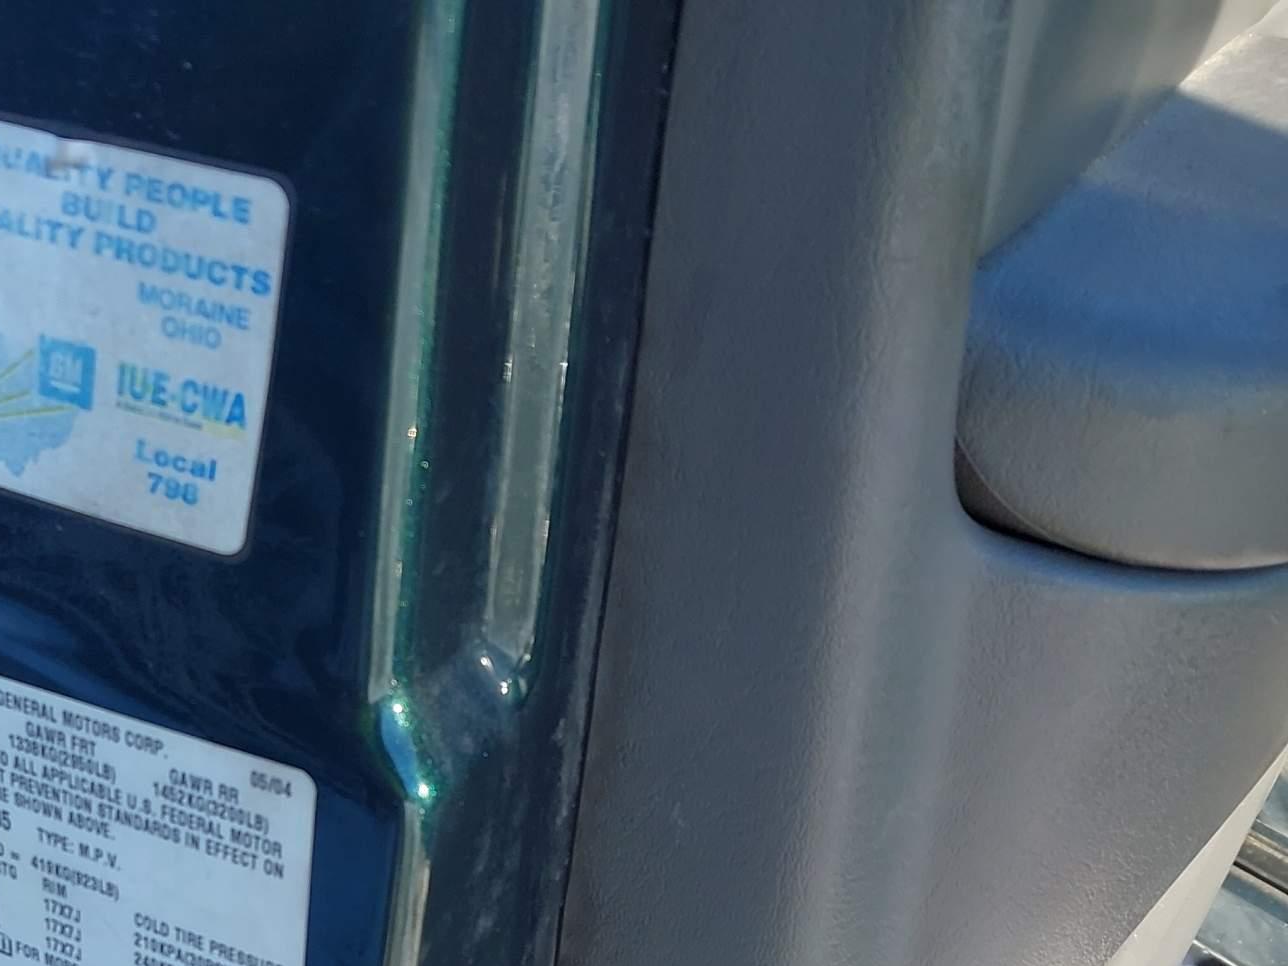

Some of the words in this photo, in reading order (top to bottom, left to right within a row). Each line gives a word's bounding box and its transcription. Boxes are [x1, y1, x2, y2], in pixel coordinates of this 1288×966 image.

[62, 191, 157, 234] BUILD
[125, 173, 252, 225] PEOPLE
[94, 230, 271, 295] PRODUCTS
[139, 281, 251, 331] MORAINE
[161, 316, 222, 350] OHIO
[50, 350, 83, 383] GM
[117, 363, 246, 430] IUE-CWA
[136, 438, 217, 482] Local
[25, 720, 66, 748] GAWR
[70, 734, 95, 756] FRT
[61, 709, 120, 742] MOTORS
[124, 730, 168, 758] CORP.
[13, 791, 62, 820] SHOWN
[13, 755, 36, 776] ALL
[41, 765, 120, 805] APPLICABLE
[161, 804, 223, 839] FEDERAL
[230, 827, 281, 858] MOTOR
[169, 768, 212, 795] GAWR
[218, 783, 238, 804] RR
[10, 771, 91, 813] PREVENTION
[97, 802, 180, 843] STANDARDS
[185, 832, 199, 849] IN
[205, 838, 258, 869] EFFECT
[263, 858, 283, 878] ON
[42, 877, 66, 897] RIM
[15, 940, 39, 961] FOR
[134, 912, 169, 937] COLD
[174, 926, 203, 950] TIRE
